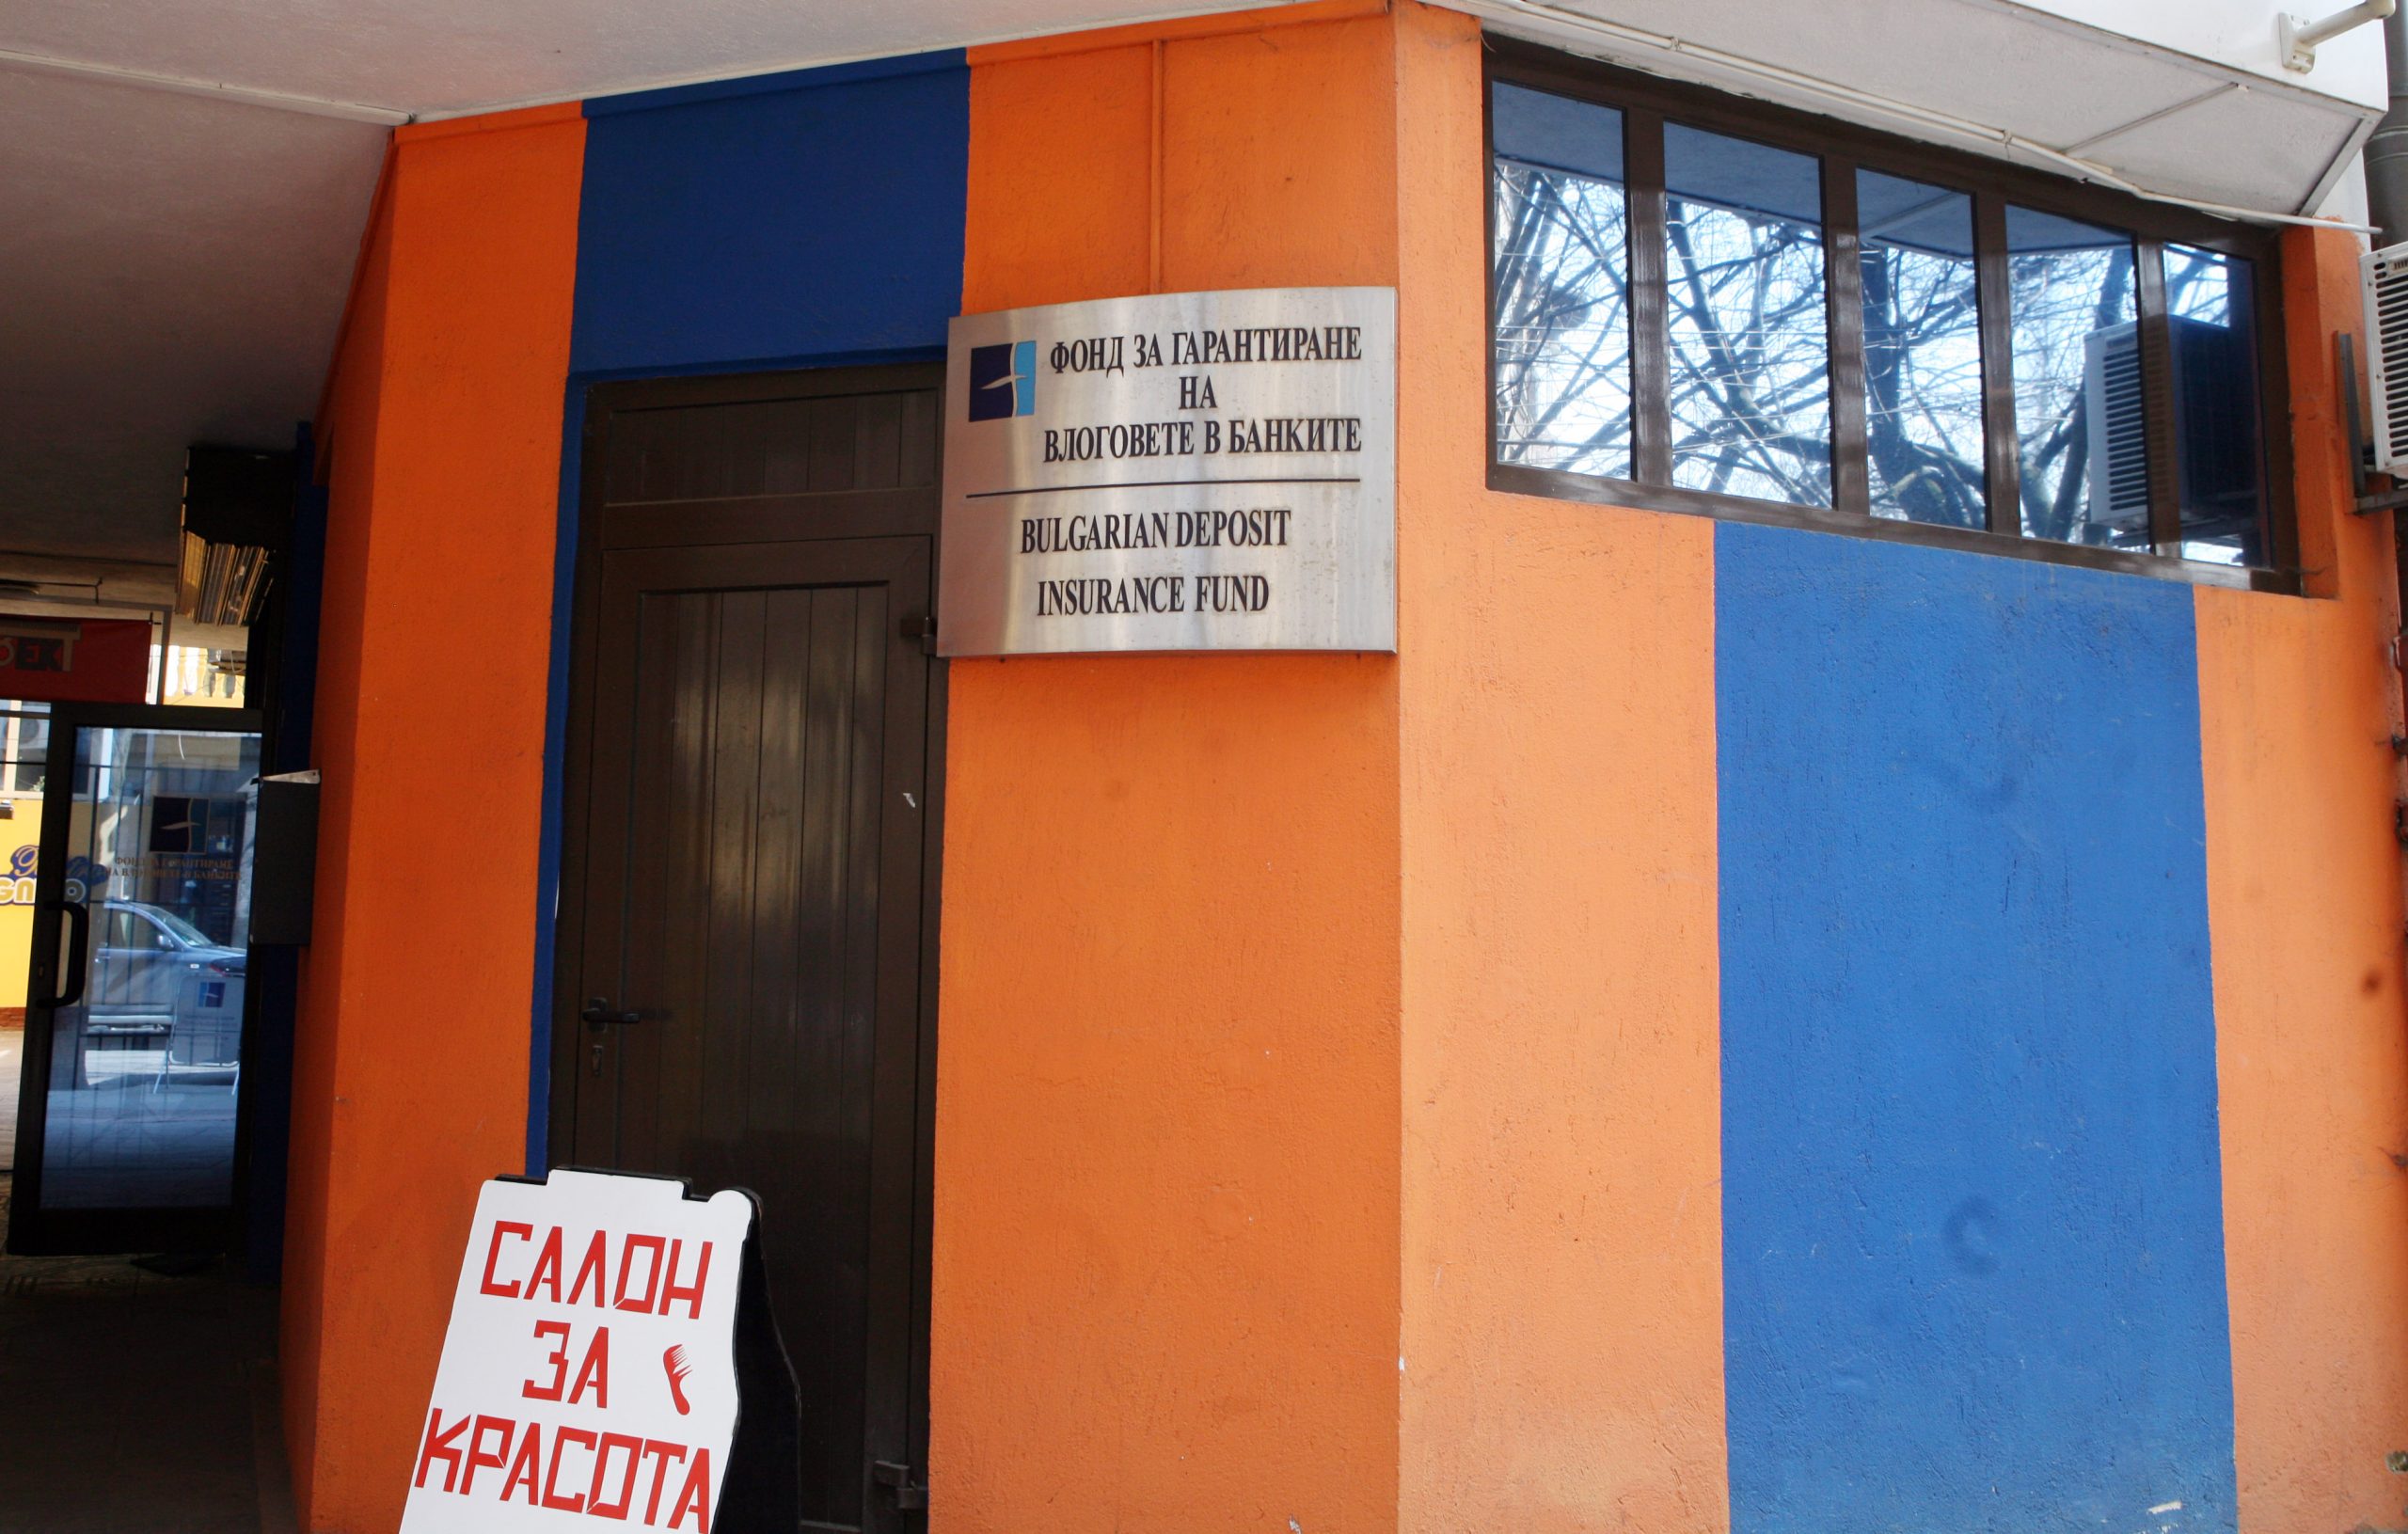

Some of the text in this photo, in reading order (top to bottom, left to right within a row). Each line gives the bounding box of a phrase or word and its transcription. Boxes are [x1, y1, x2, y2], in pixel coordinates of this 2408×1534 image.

[1050, 326, 1362, 377] ФОНД ЗА ГАРАНТИРАНЕ
[1179, 375, 1217, 410] НА
[1044, 418, 1362, 463] ВЛОГОВЕТЕ В БАНКИТЕ
[1021, 510, 1291, 554] BULGARIAN DEPOSIT
[1037, 575, 1269, 616] INSURANCE FUND
[480, 1220, 713, 1320] САЛОН
[522, 1320, 609, 1408] ЗА
[414, 1408, 709, 1534] КРАСОТА
